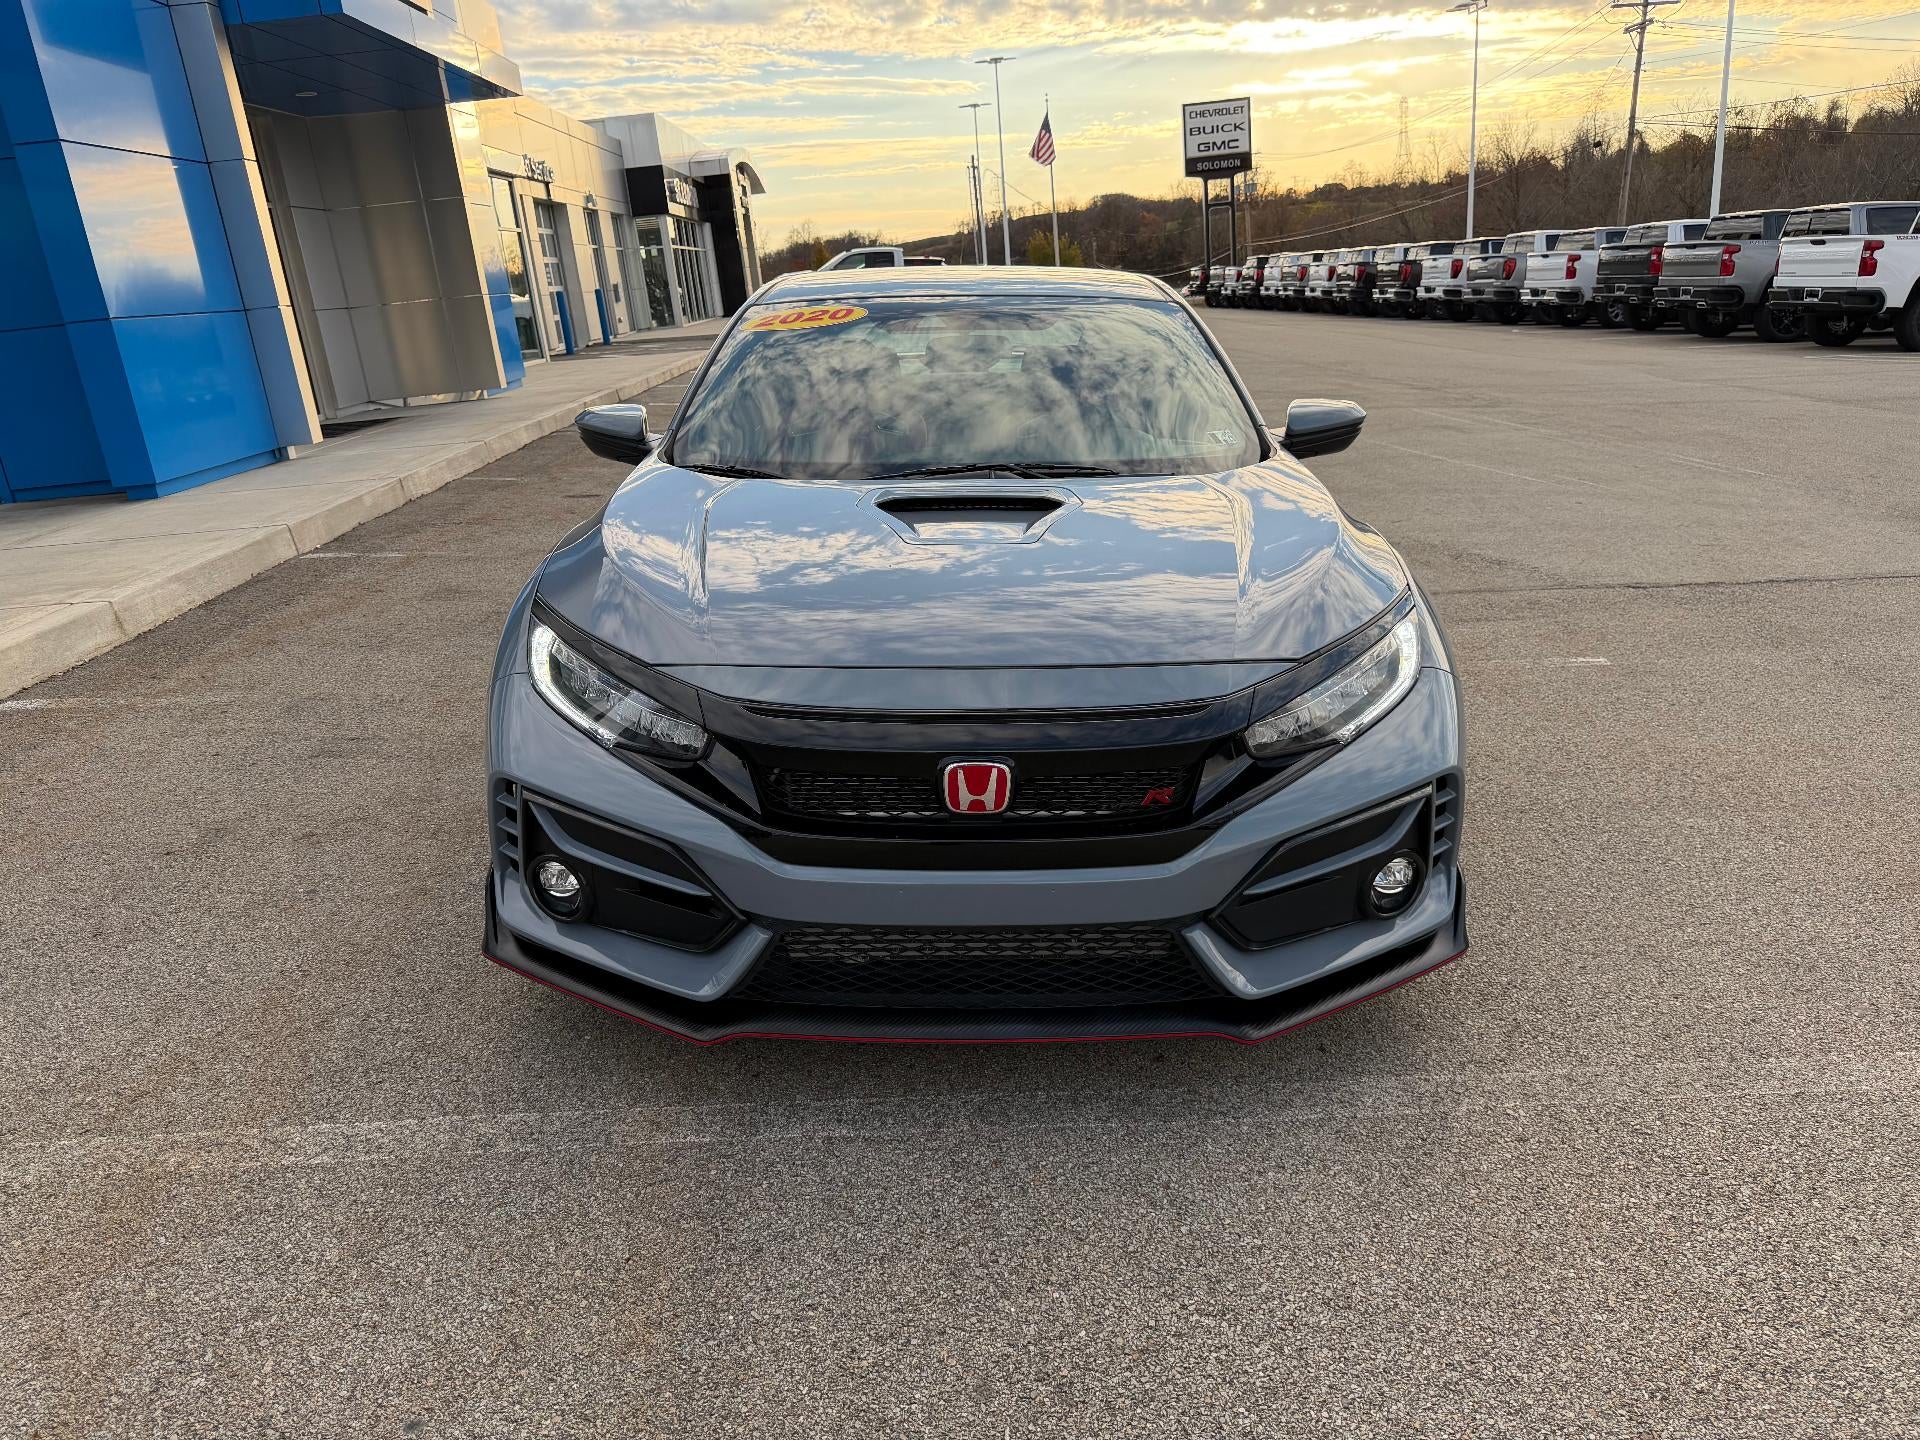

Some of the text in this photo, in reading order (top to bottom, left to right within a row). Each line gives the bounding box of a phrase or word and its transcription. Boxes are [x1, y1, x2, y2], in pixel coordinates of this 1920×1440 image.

[1190, 106, 1245, 119] CHEVROLET
[1189, 122, 1246, 136] BUICK
[1197, 139, 1240, 152] GMC
[1196, 159, 1241, 171] SOLOMON
[752, 308, 854, 328] 2020
